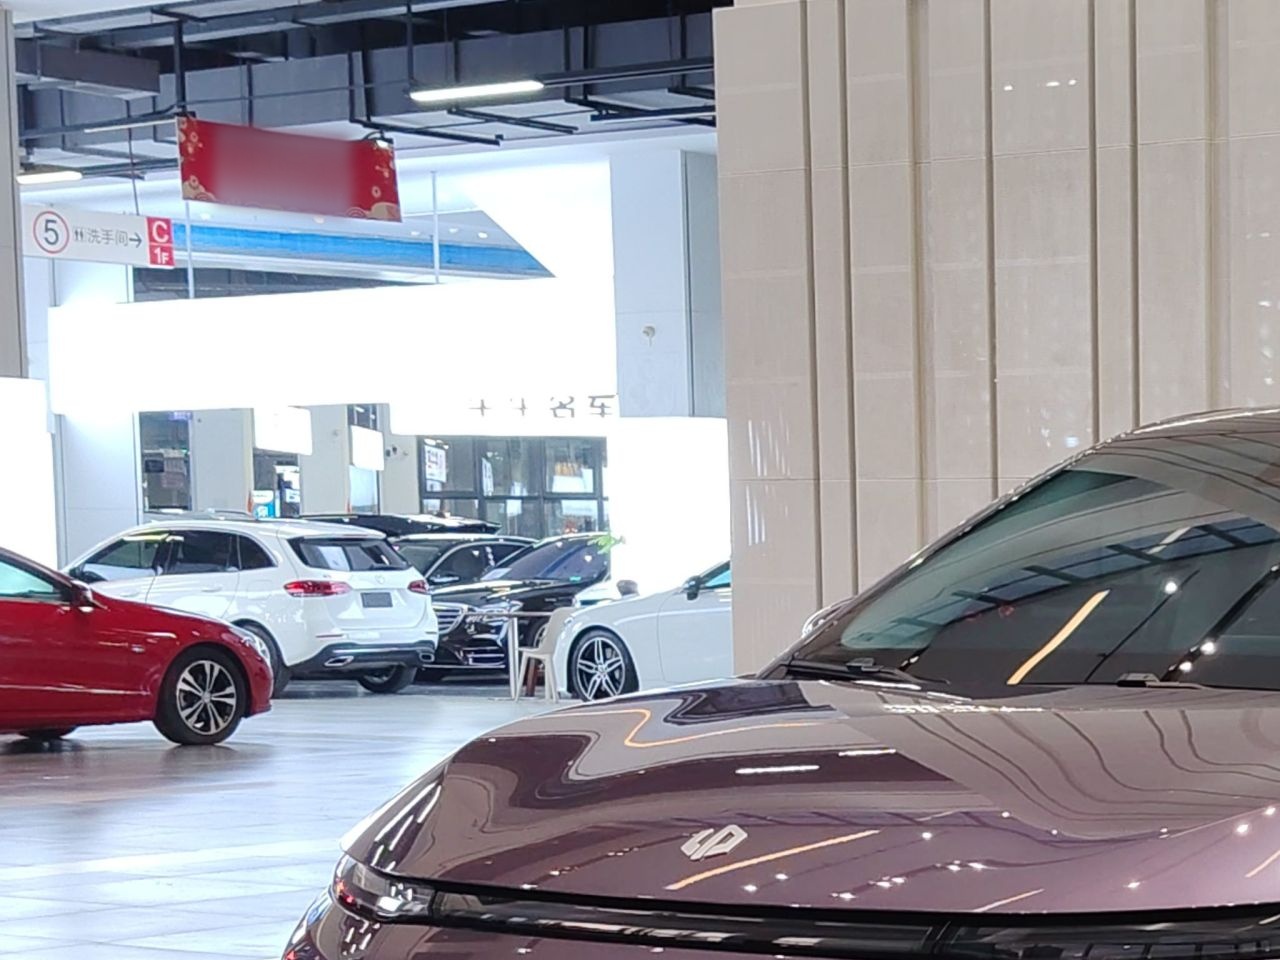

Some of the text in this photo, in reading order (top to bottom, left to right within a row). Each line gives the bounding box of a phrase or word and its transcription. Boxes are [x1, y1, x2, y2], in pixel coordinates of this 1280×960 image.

[44, 219, 59, 245] 5
[87, 226, 130, 247] 洗手间
[152, 220, 169, 243] C
[154, 247, 169, 264] 1F
